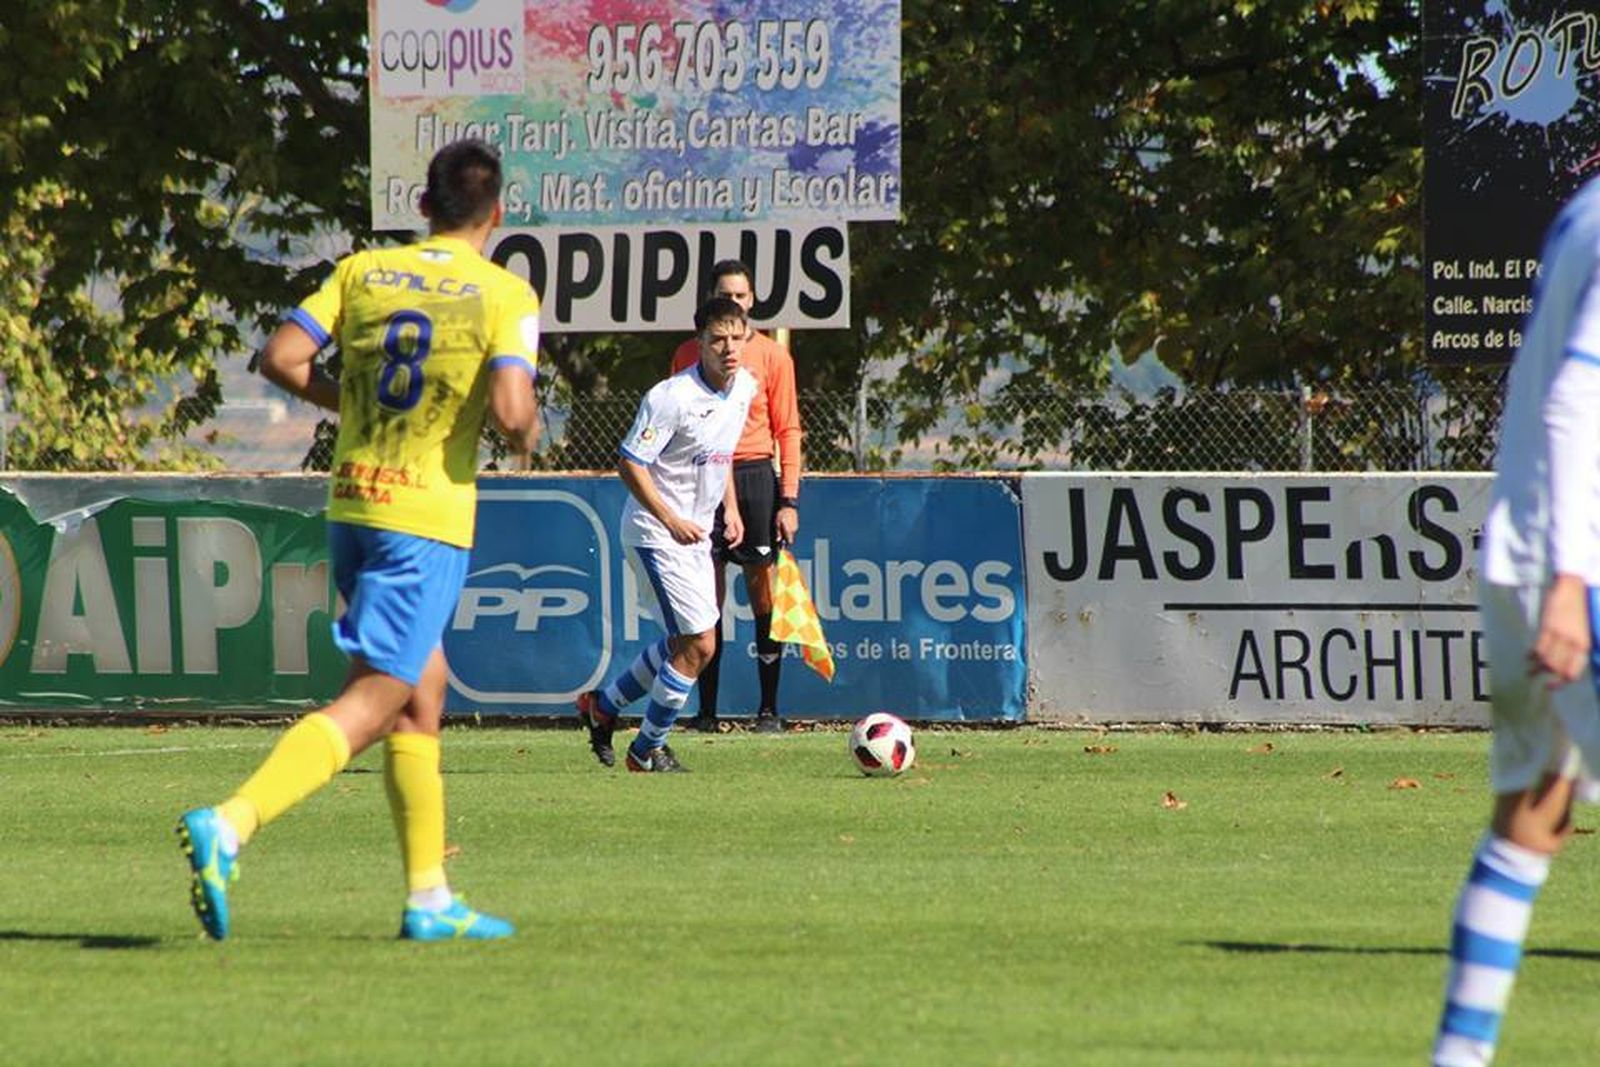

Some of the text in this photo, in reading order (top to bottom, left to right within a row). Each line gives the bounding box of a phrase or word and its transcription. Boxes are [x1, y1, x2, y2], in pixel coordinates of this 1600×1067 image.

[381, 28, 513, 89] copiplus
[587, 18, 830, 94] 956 703 559
[806, 106, 864, 147] Bar
[541, 171, 613, 213] Mat.
[623, 168, 732, 211] oficina
[741, 175, 761, 216] y
[772, 165, 897, 209] Escolar
[1432, 260, 1464, 280] Pol.
[1469, 260, 1500, 280] Ind.
[1504, 260, 1521, 279] El
[1432, 296, 1478, 315] Calle.
[378, 308, 433, 413] 8
[1432, 329, 1522, 349] Arcos de la
[30, 516, 330, 675] AiPr
[452, 587, 589, 631] PP
[623, 538, 1015, 642] pplares
[856, 637, 881, 660] de
[891, 637, 912, 660] la
[919, 637, 1017, 661] Frontera
